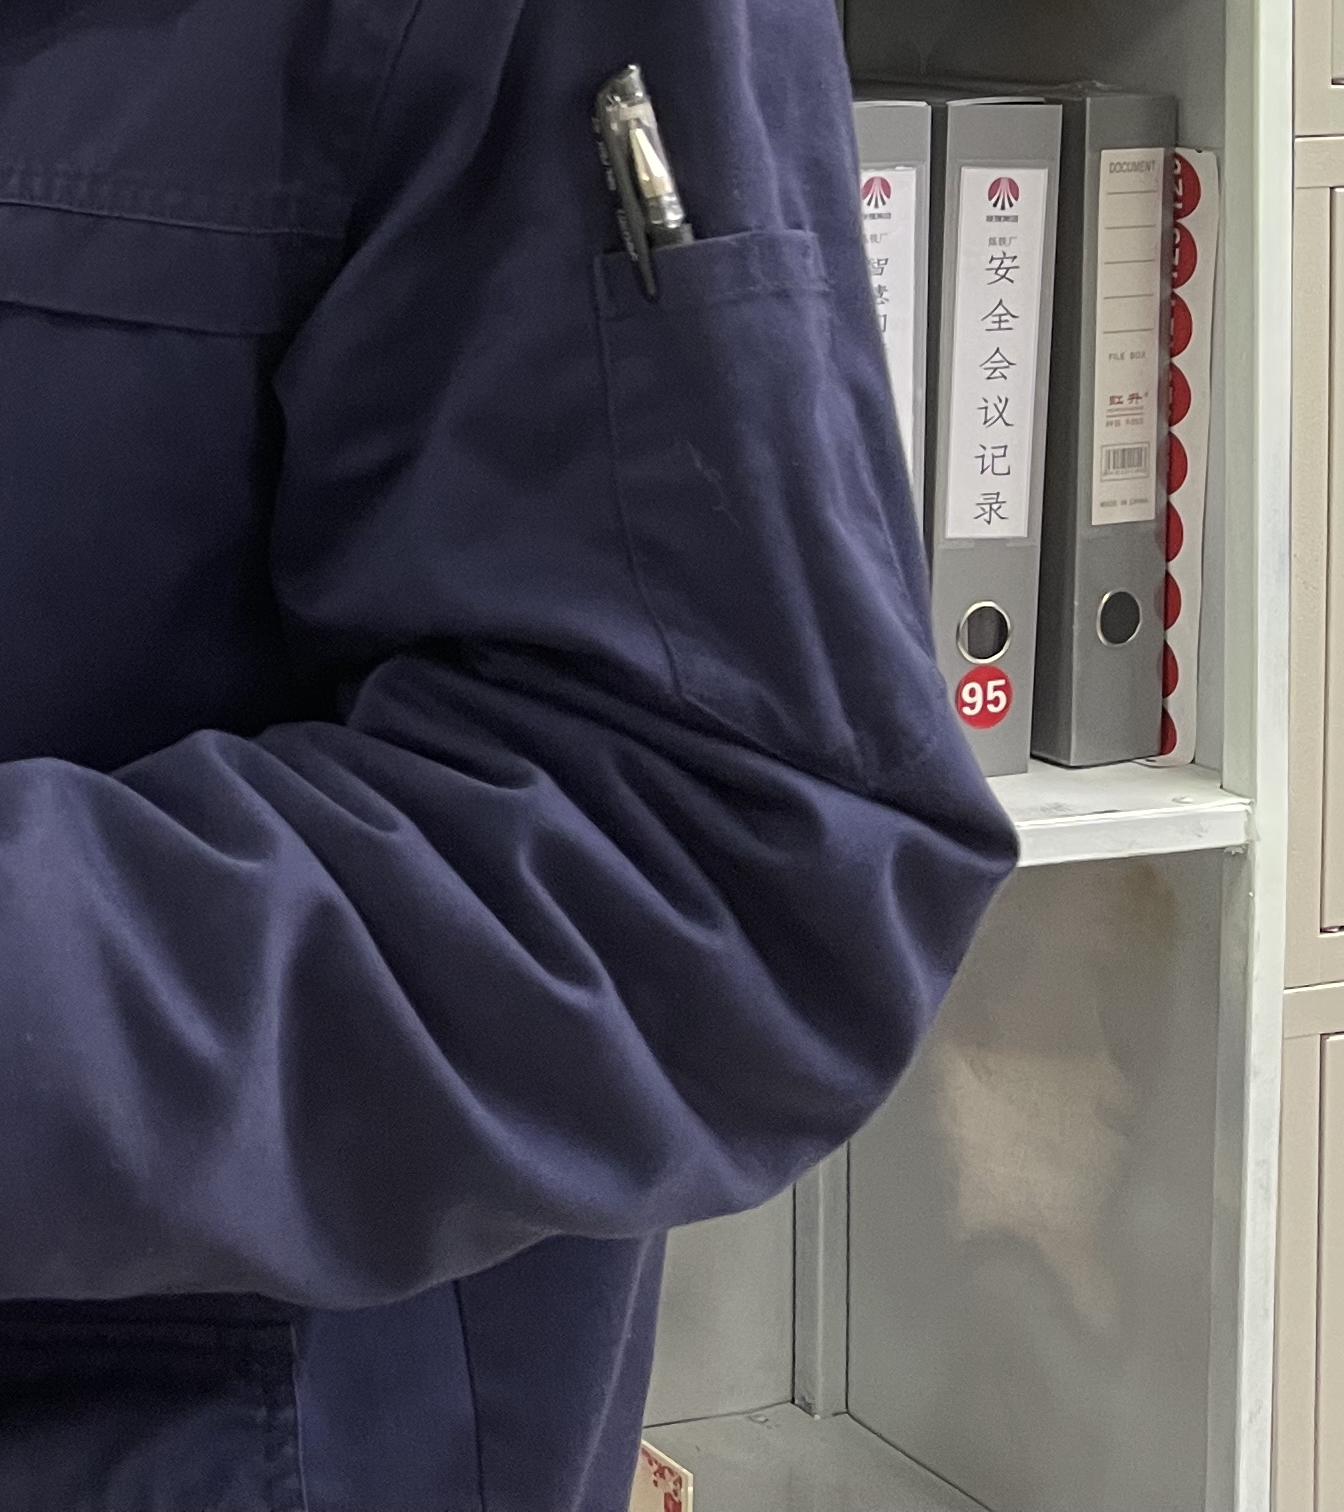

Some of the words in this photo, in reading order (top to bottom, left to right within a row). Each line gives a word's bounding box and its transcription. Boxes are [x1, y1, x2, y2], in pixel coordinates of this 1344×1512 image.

[1109, 160, 1155, 174] DOCUMENT
[974, 251, 1020, 525] 安全会议记录
[962, 680, 1006, 715] 95
